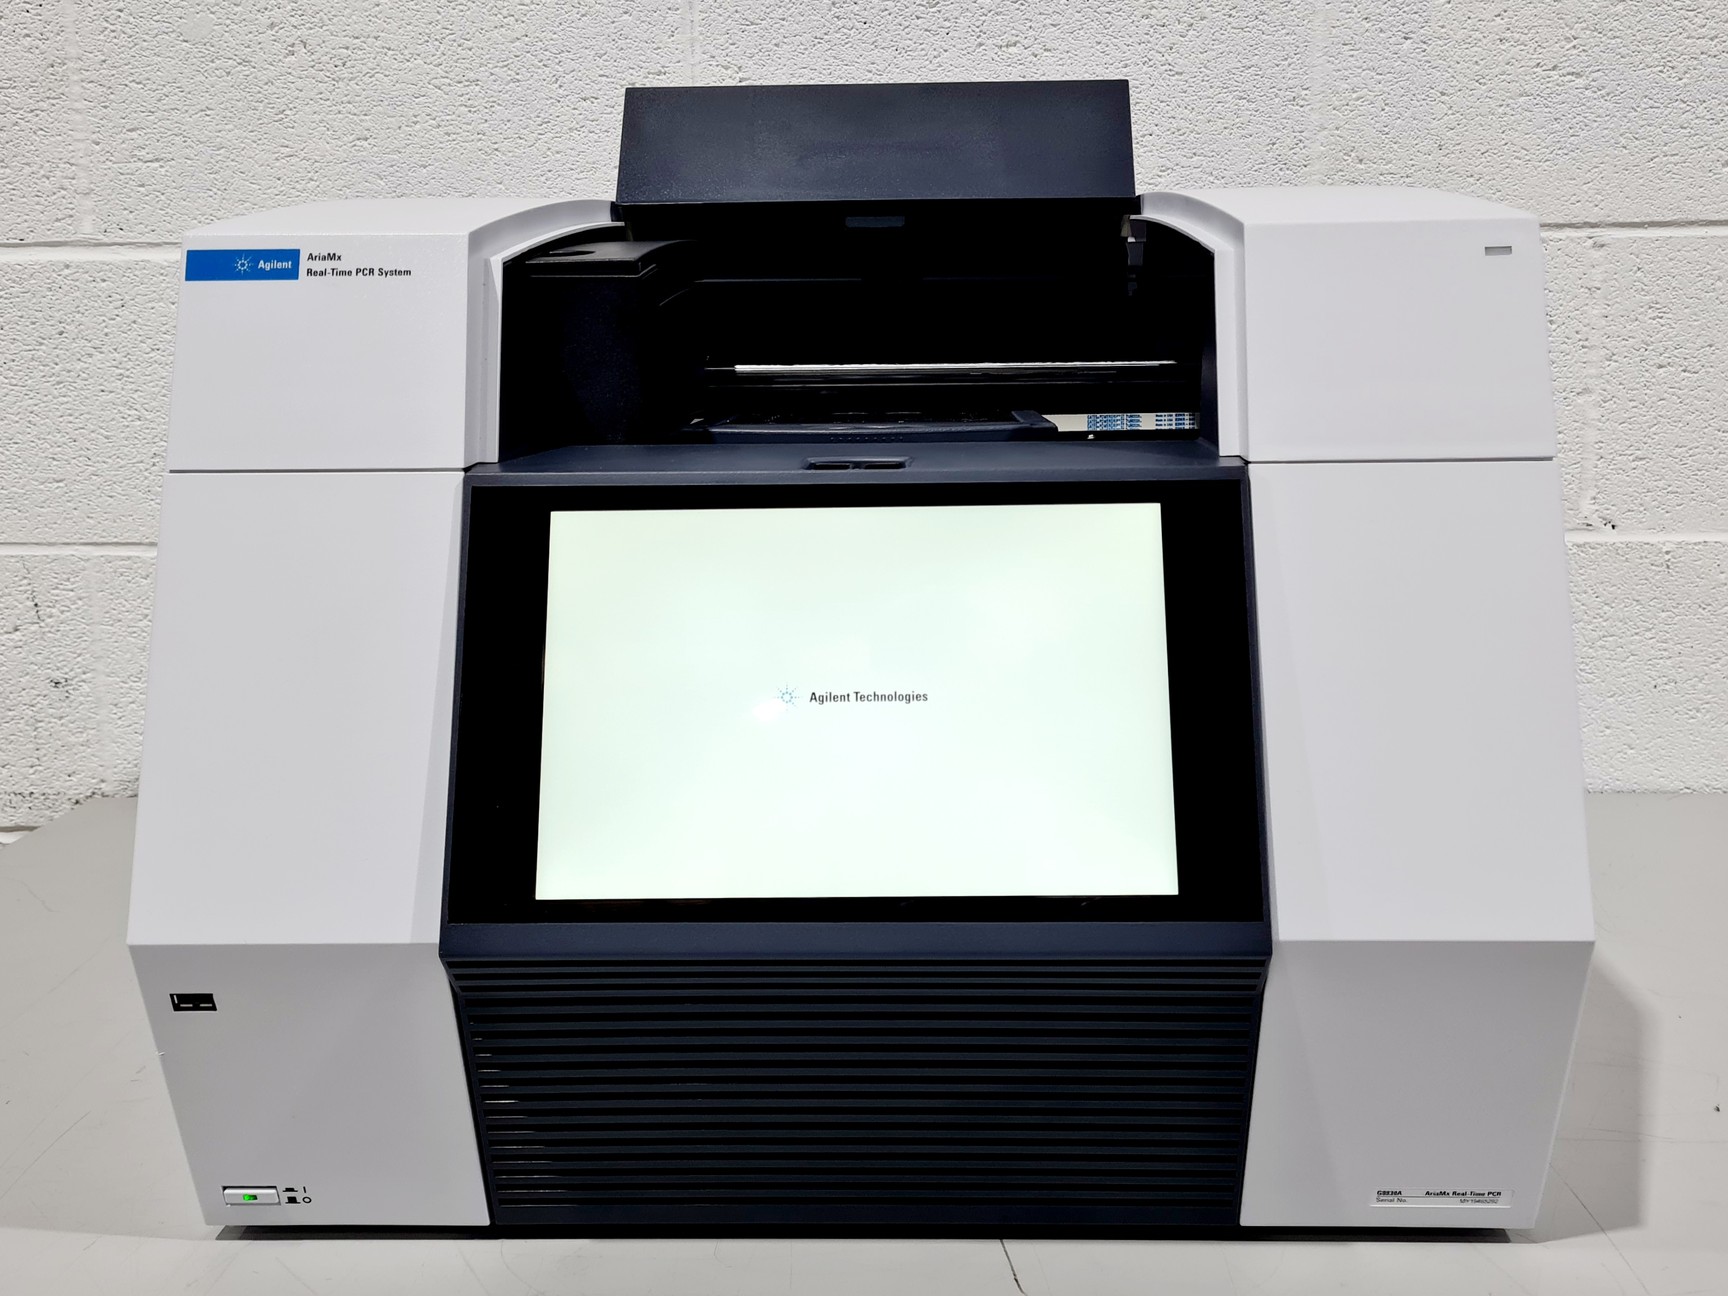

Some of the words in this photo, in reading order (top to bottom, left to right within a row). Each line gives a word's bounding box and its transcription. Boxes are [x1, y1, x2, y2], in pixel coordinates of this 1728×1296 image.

[306, 253, 342, 262] AriaMx
[257, 259, 292, 271] Agilent
[306, 267, 352, 277] Real-Time
[355, 267, 375, 277] PCR
[377, 267, 412, 279] System
[809, 692, 850, 705] Agilent
[852, 691, 928, 704] Technologies
